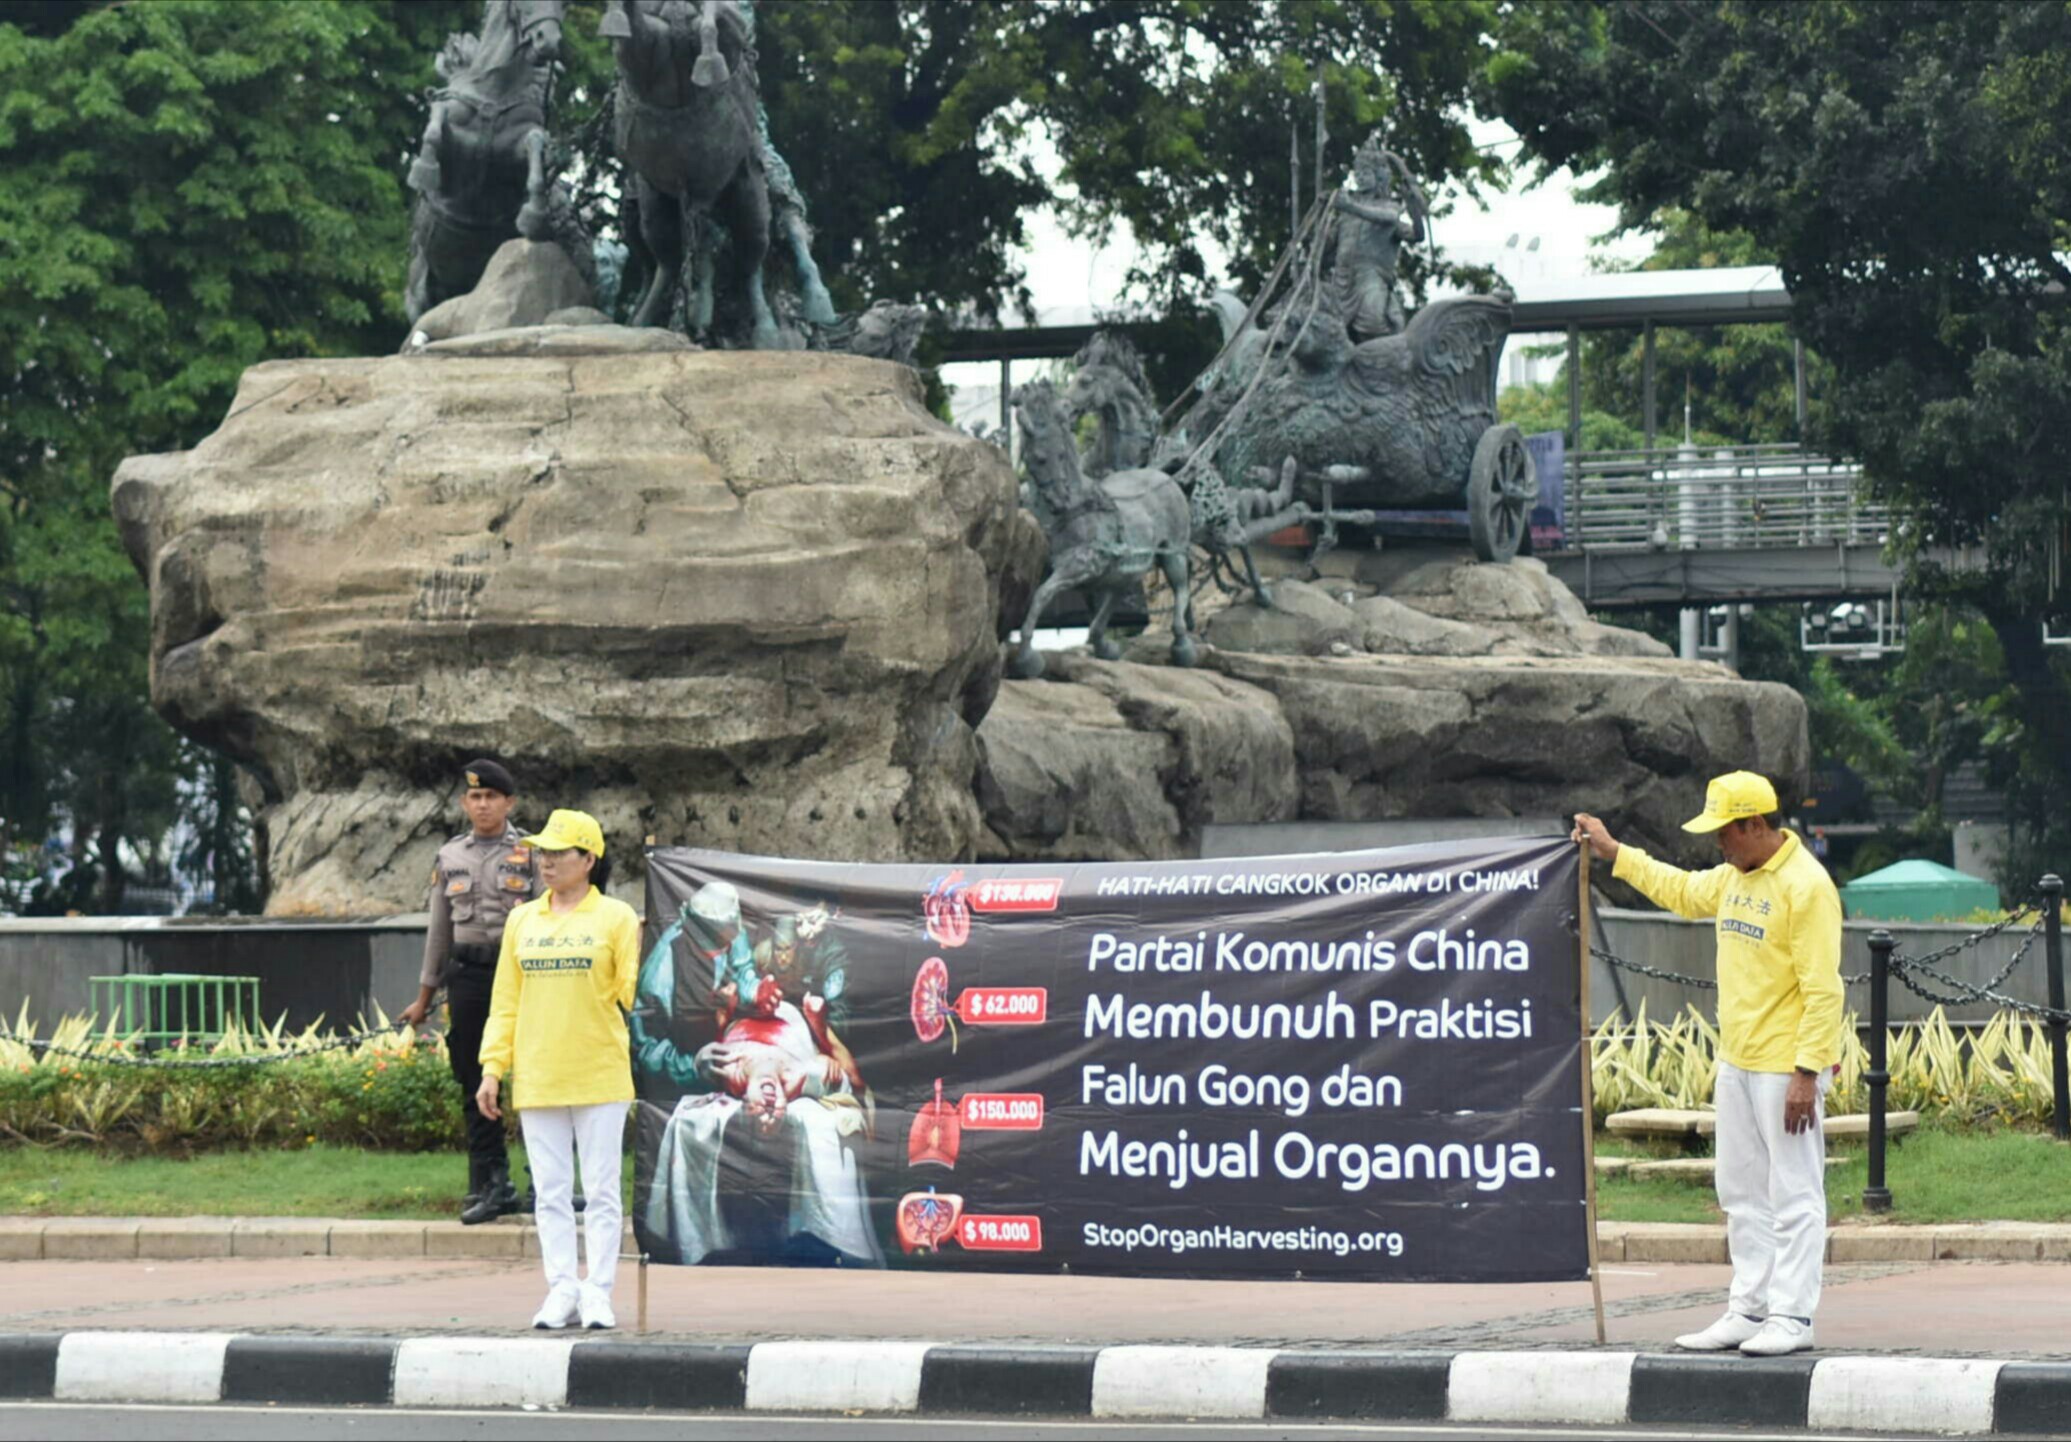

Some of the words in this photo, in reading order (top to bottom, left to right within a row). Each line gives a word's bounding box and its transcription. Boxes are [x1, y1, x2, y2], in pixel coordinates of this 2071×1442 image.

[1097, 874, 1212, 896] HATI-HATI
[1216, 873, 1331, 895] CANGKOK
[1336, 872, 1423, 894] ORGAN
[1427, 872, 1451, 893] DI
[1459, 868, 1540, 892] CHINA!
[1088, 931, 1207, 972] Partai
[1215, 930, 1396, 972] Komunis
[1407, 928, 1530, 971] China
[985, 994, 1038, 1014] 62.000
[1084, 990, 1355, 1039] Membunuh
[1370, 998, 1532, 1039] Praktisi
[1082, 1062, 1187, 1105] Falun
[1198, 1064, 1311, 1117] Gong
[1321, 1063, 1402, 1106] dan
[968, 1098, 1038, 1121] $150.000
[1080, 1128, 1259, 1189] Menjual
[1273, 1130, 1556, 1191] Organnya.
[979, 1222, 1031, 1242] 98.000
[1083, 1222, 1404, 1257] StopOrganHarvesting.org
